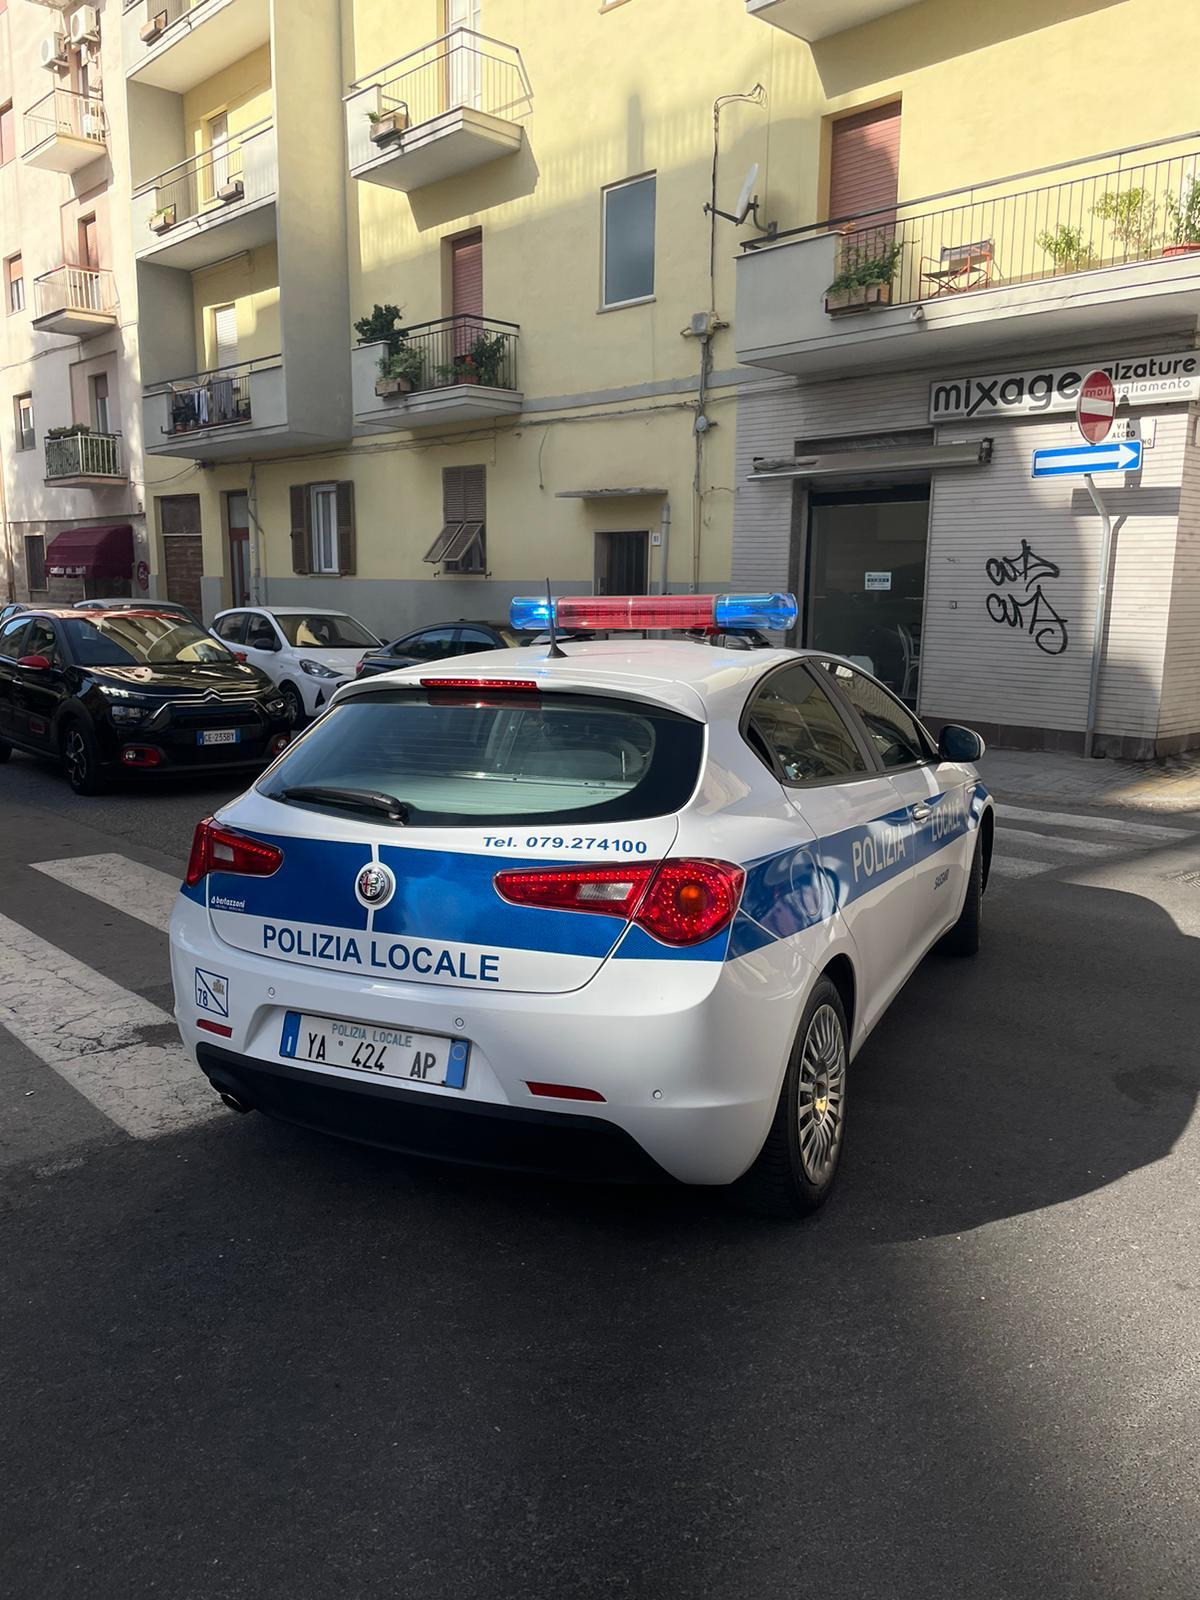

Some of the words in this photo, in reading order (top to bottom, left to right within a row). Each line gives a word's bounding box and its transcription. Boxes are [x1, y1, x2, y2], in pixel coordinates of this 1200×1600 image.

[933, 371, 1082, 417] mixage
[1112, 431, 1136, 439] ALCEO
[1117, 422, 1130, 430] VIA
[483, 836, 517, 848] Tel.
[526, 837, 647, 854] 079.274100
[852, 822, 906, 883] POLIZIA
[931, 798, 961, 843] LOCALE
[263, 924, 362, 964] POLIZIA
[370, 940, 500, 982] LOCALE
[198, 988, 208, 1006] 78
[331, 1023, 367, 1040] POLIZIA
[372, 1029, 413, 1048] LOCALE
[308, 1033, 327, 1061] YA
[351, 1041, 388, 1072] 424
[409, 1051, 437, 1079] AP
